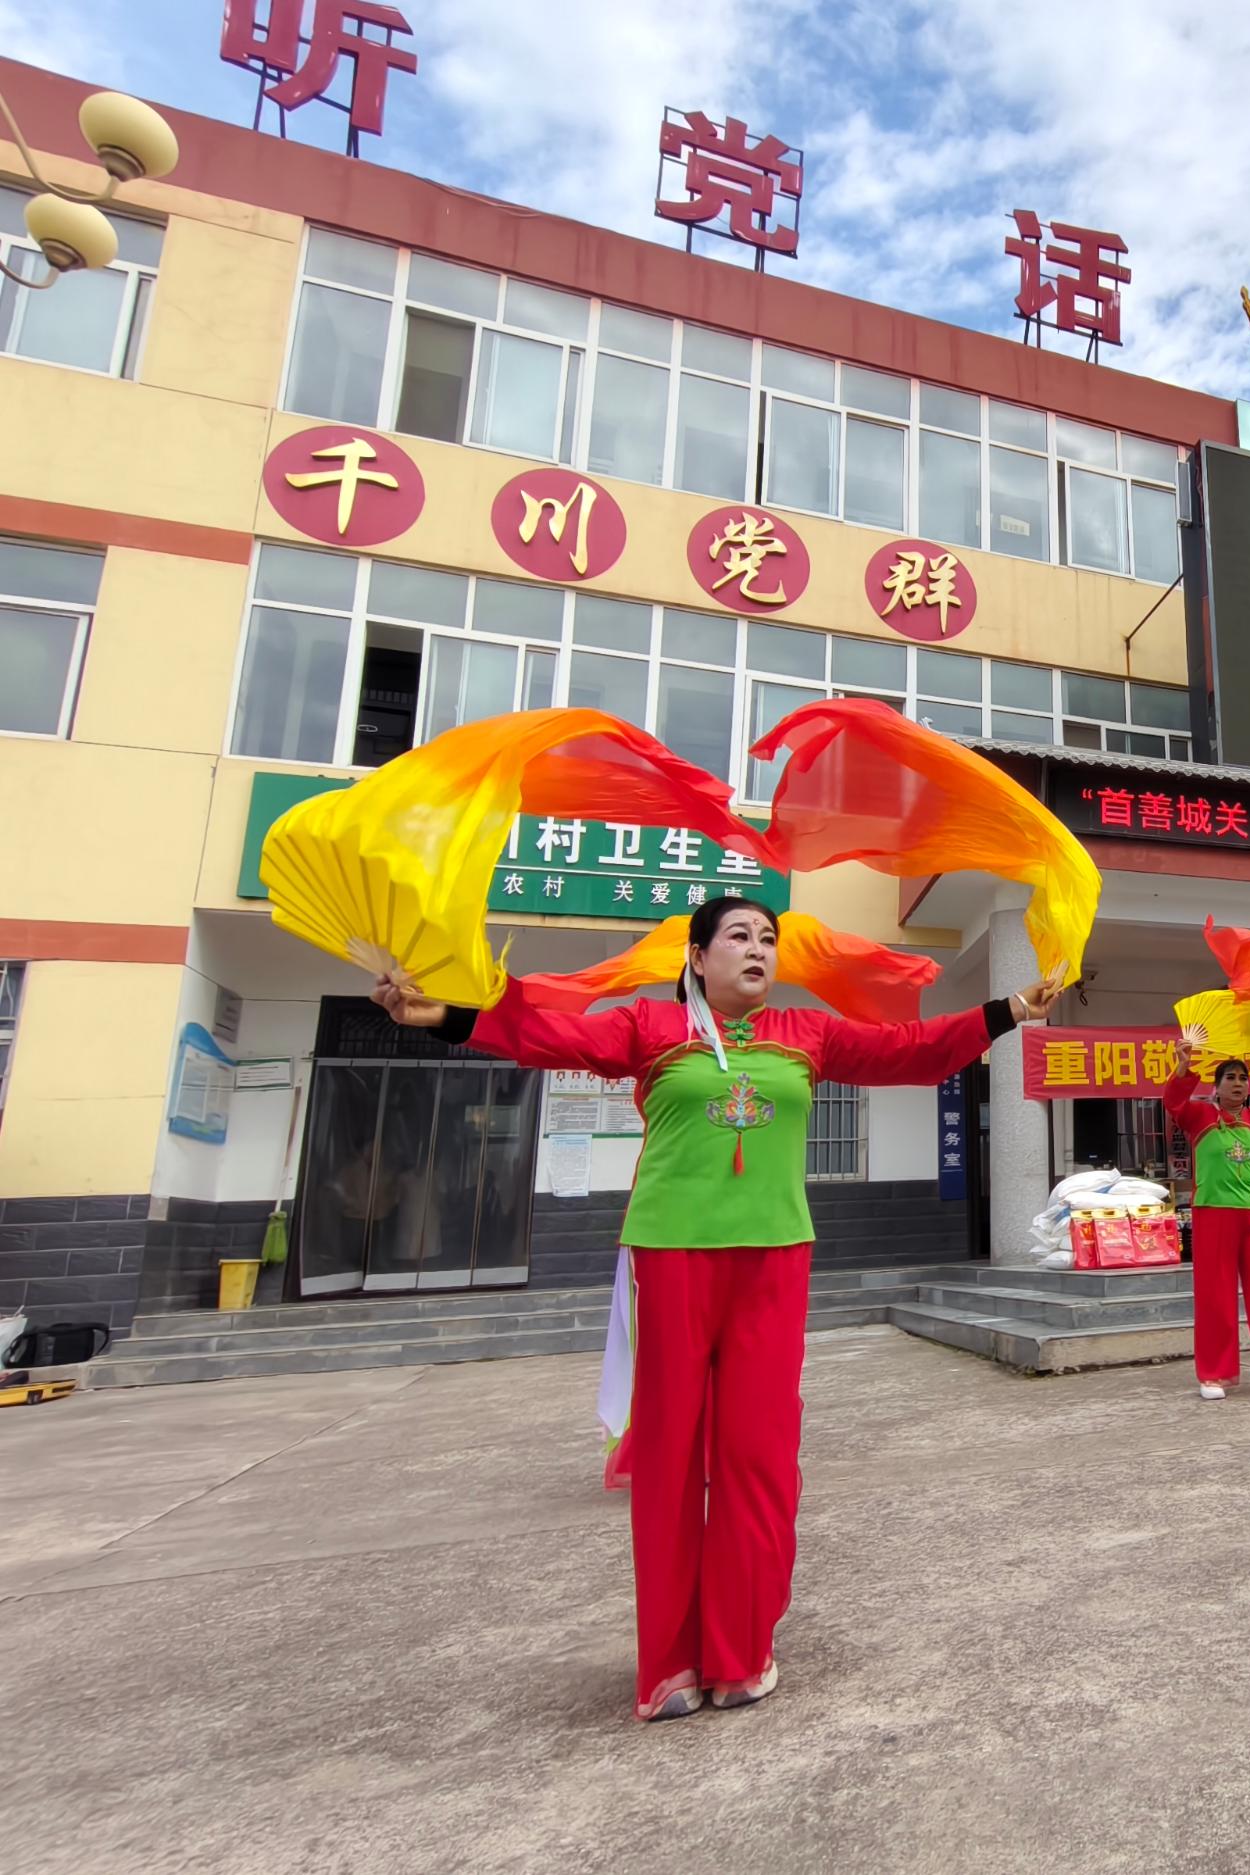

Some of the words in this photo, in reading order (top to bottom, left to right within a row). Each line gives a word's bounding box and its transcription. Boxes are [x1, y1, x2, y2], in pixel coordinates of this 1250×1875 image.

[508, 812, 762, 876] 村卫生
[502, 872, 565, 898] 农村
